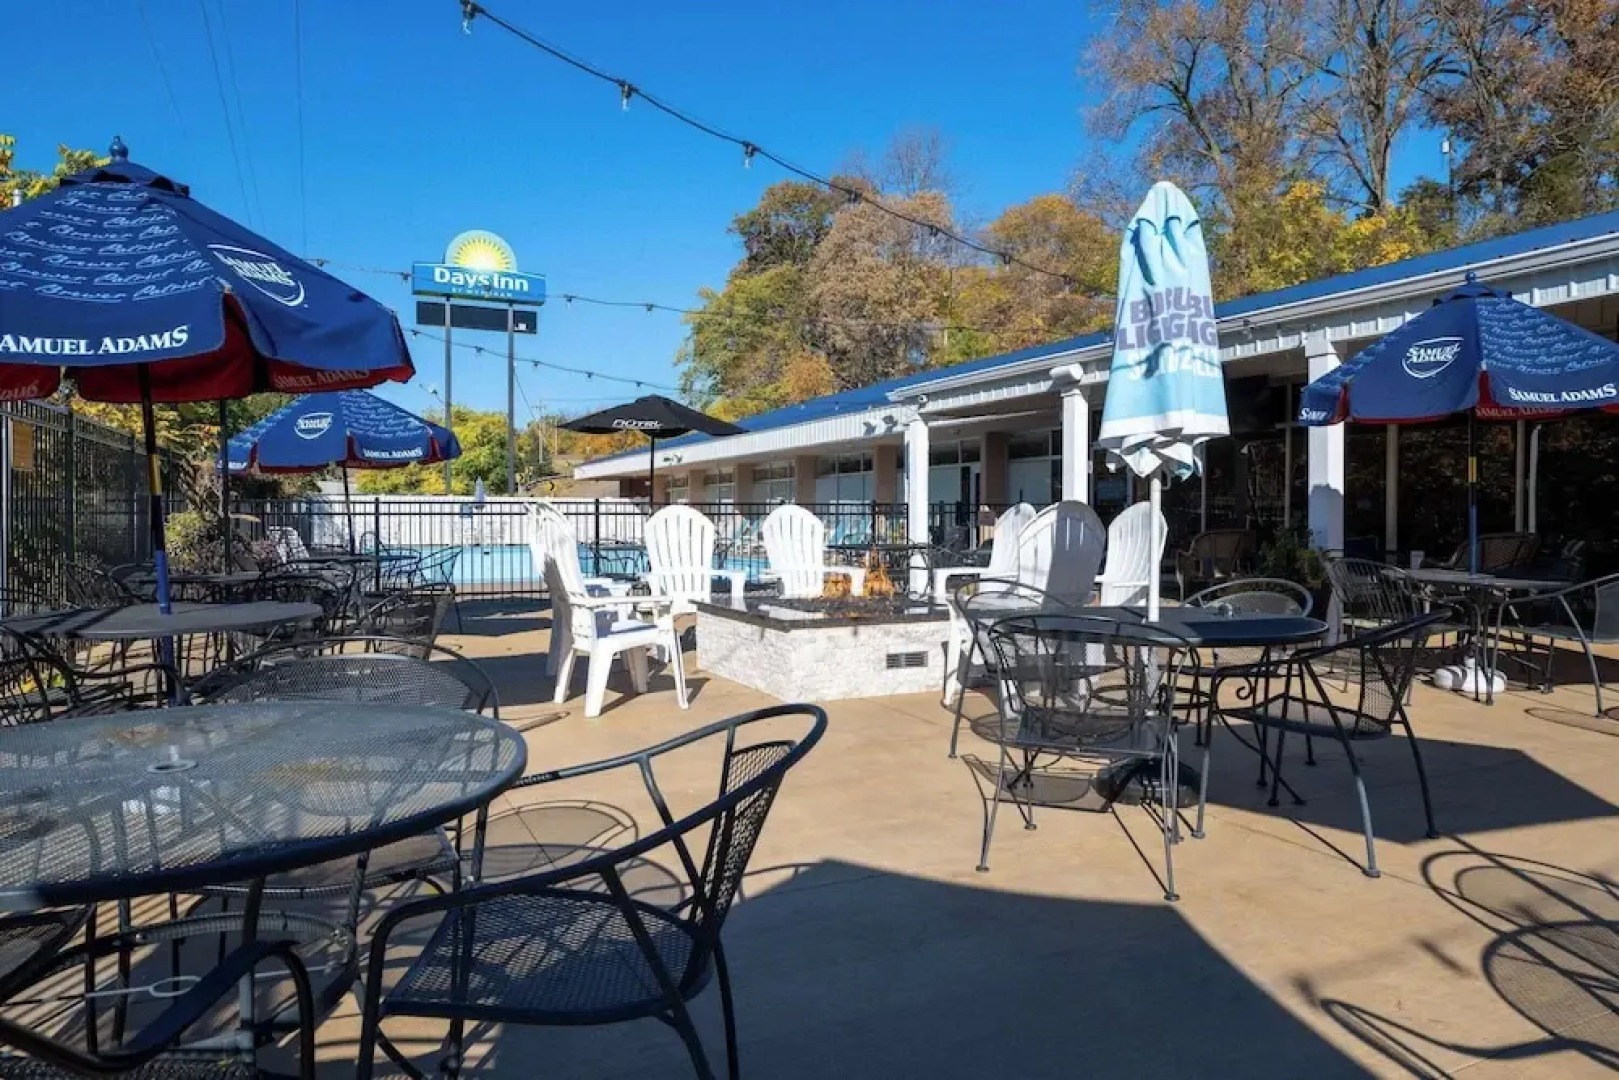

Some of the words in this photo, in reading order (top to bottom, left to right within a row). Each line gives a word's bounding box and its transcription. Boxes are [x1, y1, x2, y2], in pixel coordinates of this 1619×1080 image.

[434, 266, 490, 289] Days
[493, 273, 529, 292] Inn
[0, 333, 95, 355] AMUEL
[97, 324, 191, 355] ADAMS
[1509, 387, 1560, 403] SAMUEL
[1561, 383, 1617, 402] ADAMS
